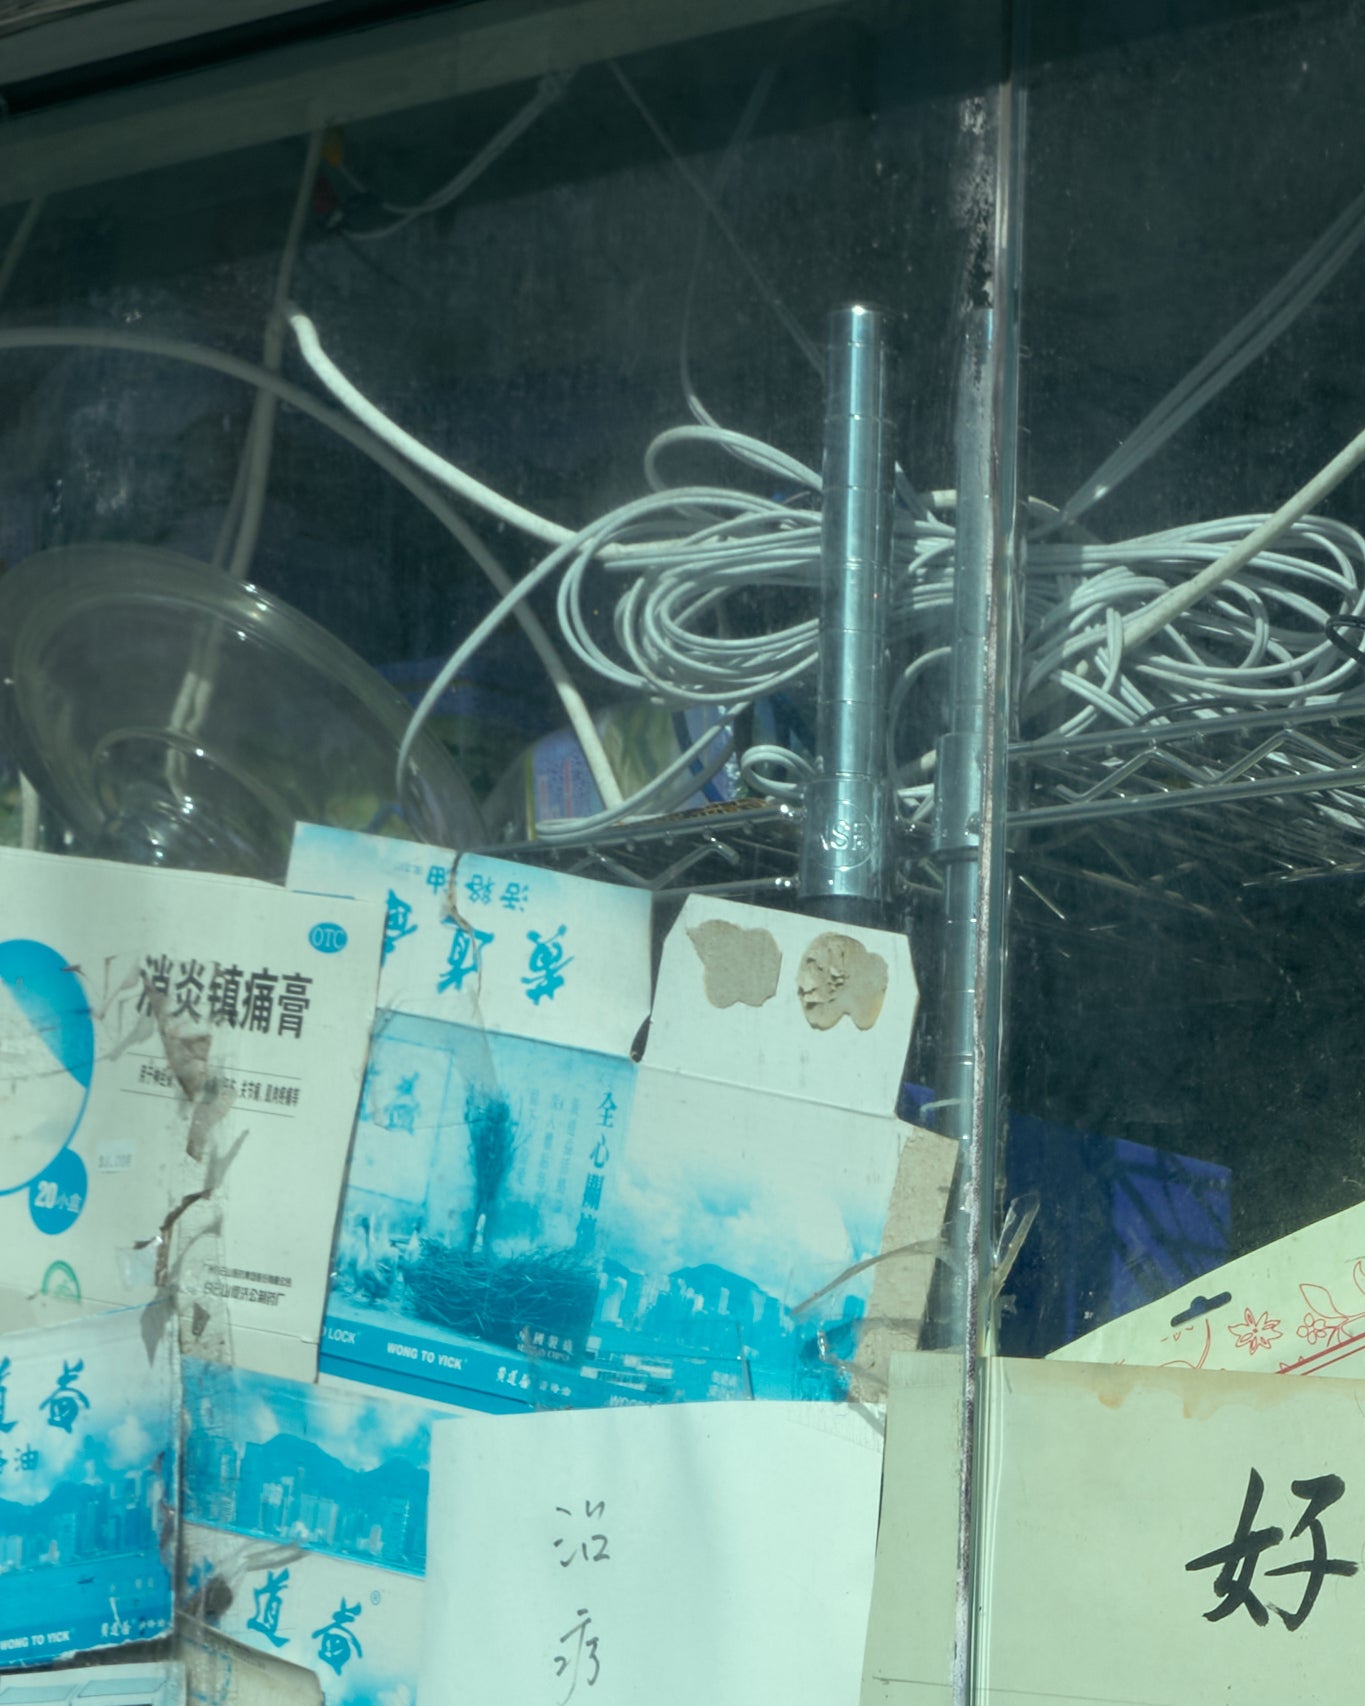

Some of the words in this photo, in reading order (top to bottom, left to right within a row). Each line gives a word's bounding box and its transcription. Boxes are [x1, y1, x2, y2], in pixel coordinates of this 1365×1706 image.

[310, 927, 345, 948] OTC
[136, 954, 314, 1040] 消炎镇痛膏
[328, 1329, 356, 1345] LOCK
[387, 1342, 418, 1360] WONG
[421, 1347, 435, 1363] TO
[437, 1352, 463, 1370] YICK
